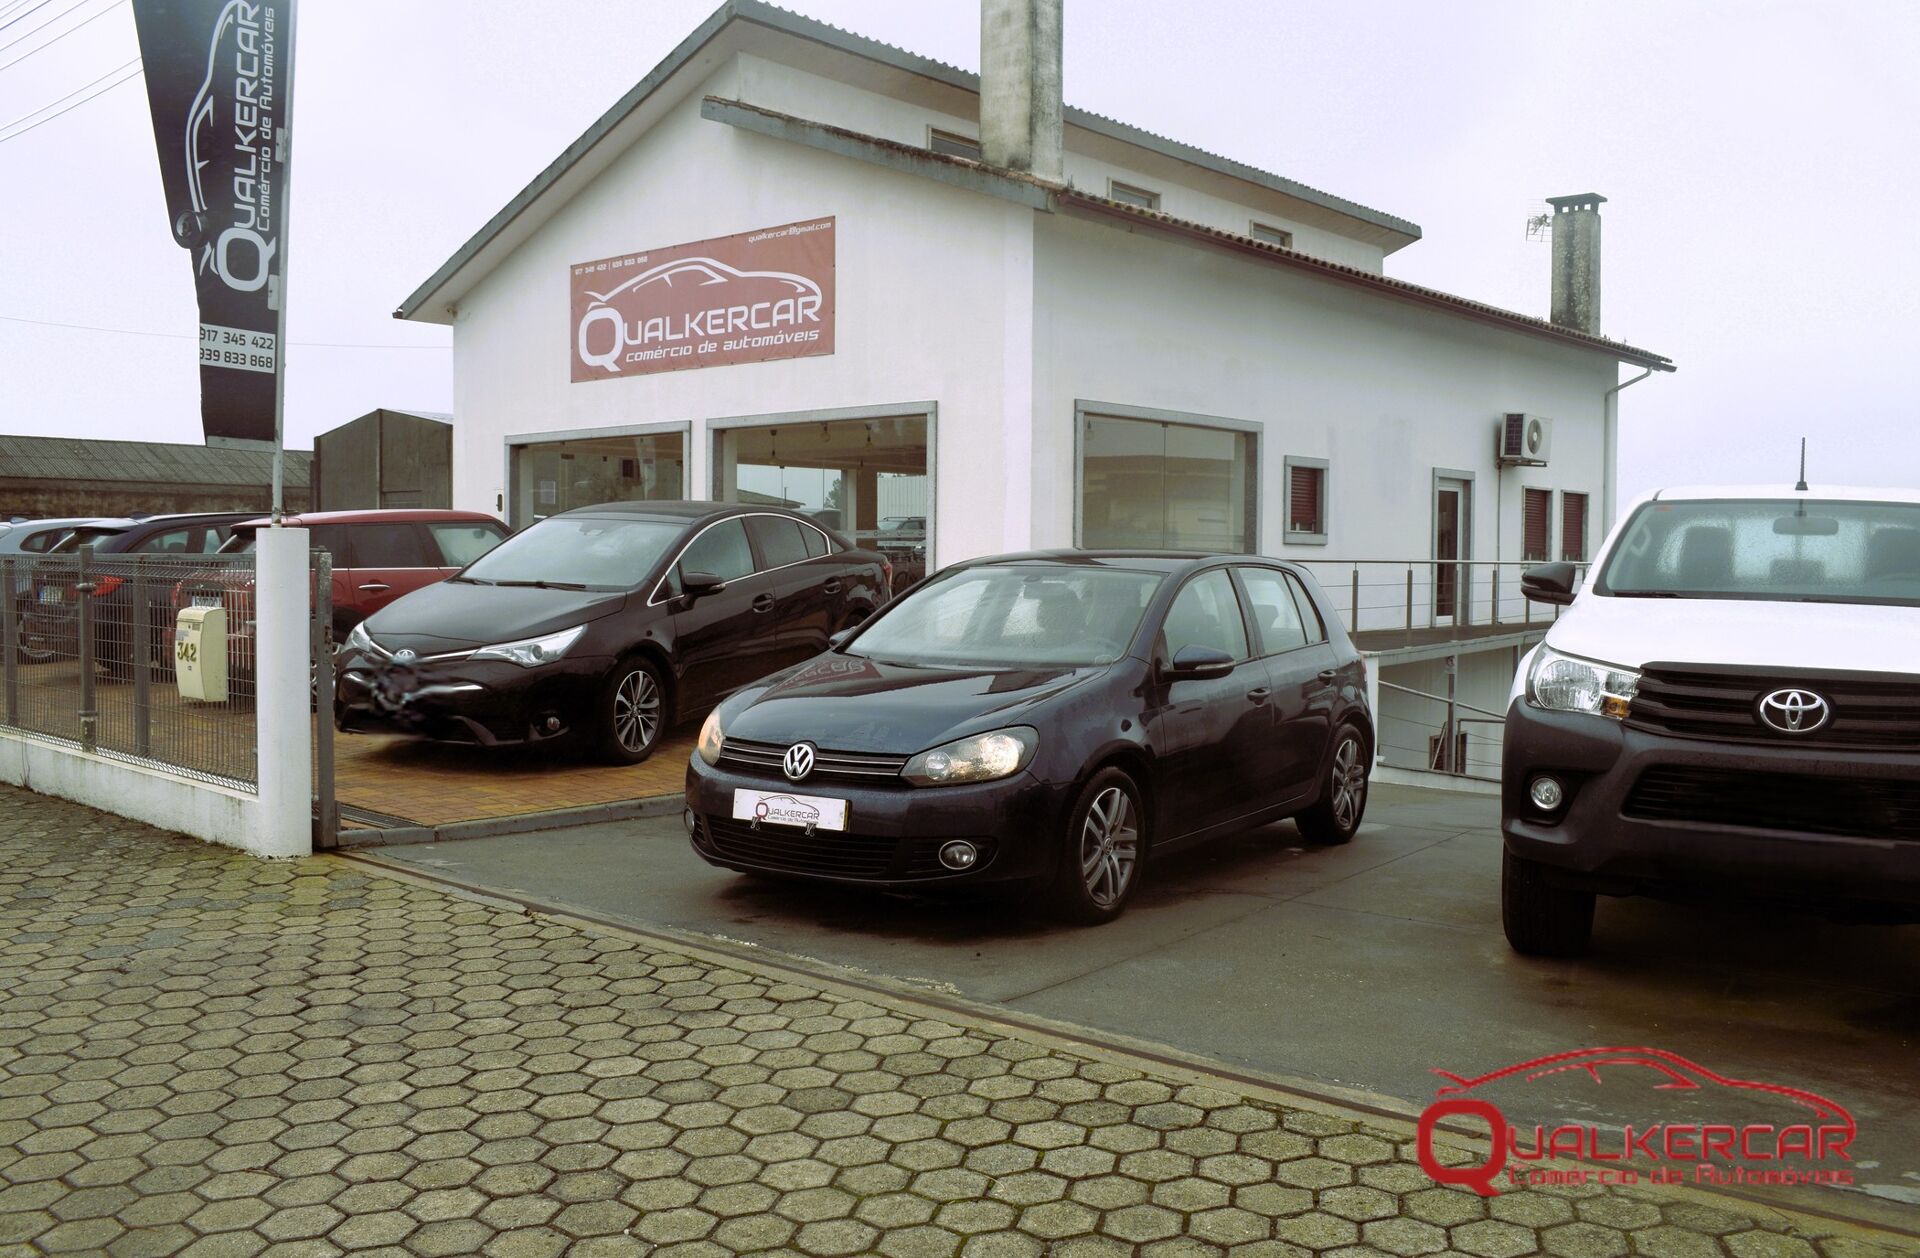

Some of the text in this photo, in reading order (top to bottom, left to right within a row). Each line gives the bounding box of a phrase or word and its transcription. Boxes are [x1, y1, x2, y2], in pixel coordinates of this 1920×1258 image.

[257, 7, 275, 232] Comércio de Automóveis
[223, 331, 246, 346] 345
[251, 336, 274, 350] 422
[578, 295, 823, 372] QUALKERCAR
[626, 330, 820, 363] comércio de automóveis
[224, 351, 247, 365] 833
[250, 354, 273, 369] 868
[177, 642, 197, 662] 342
